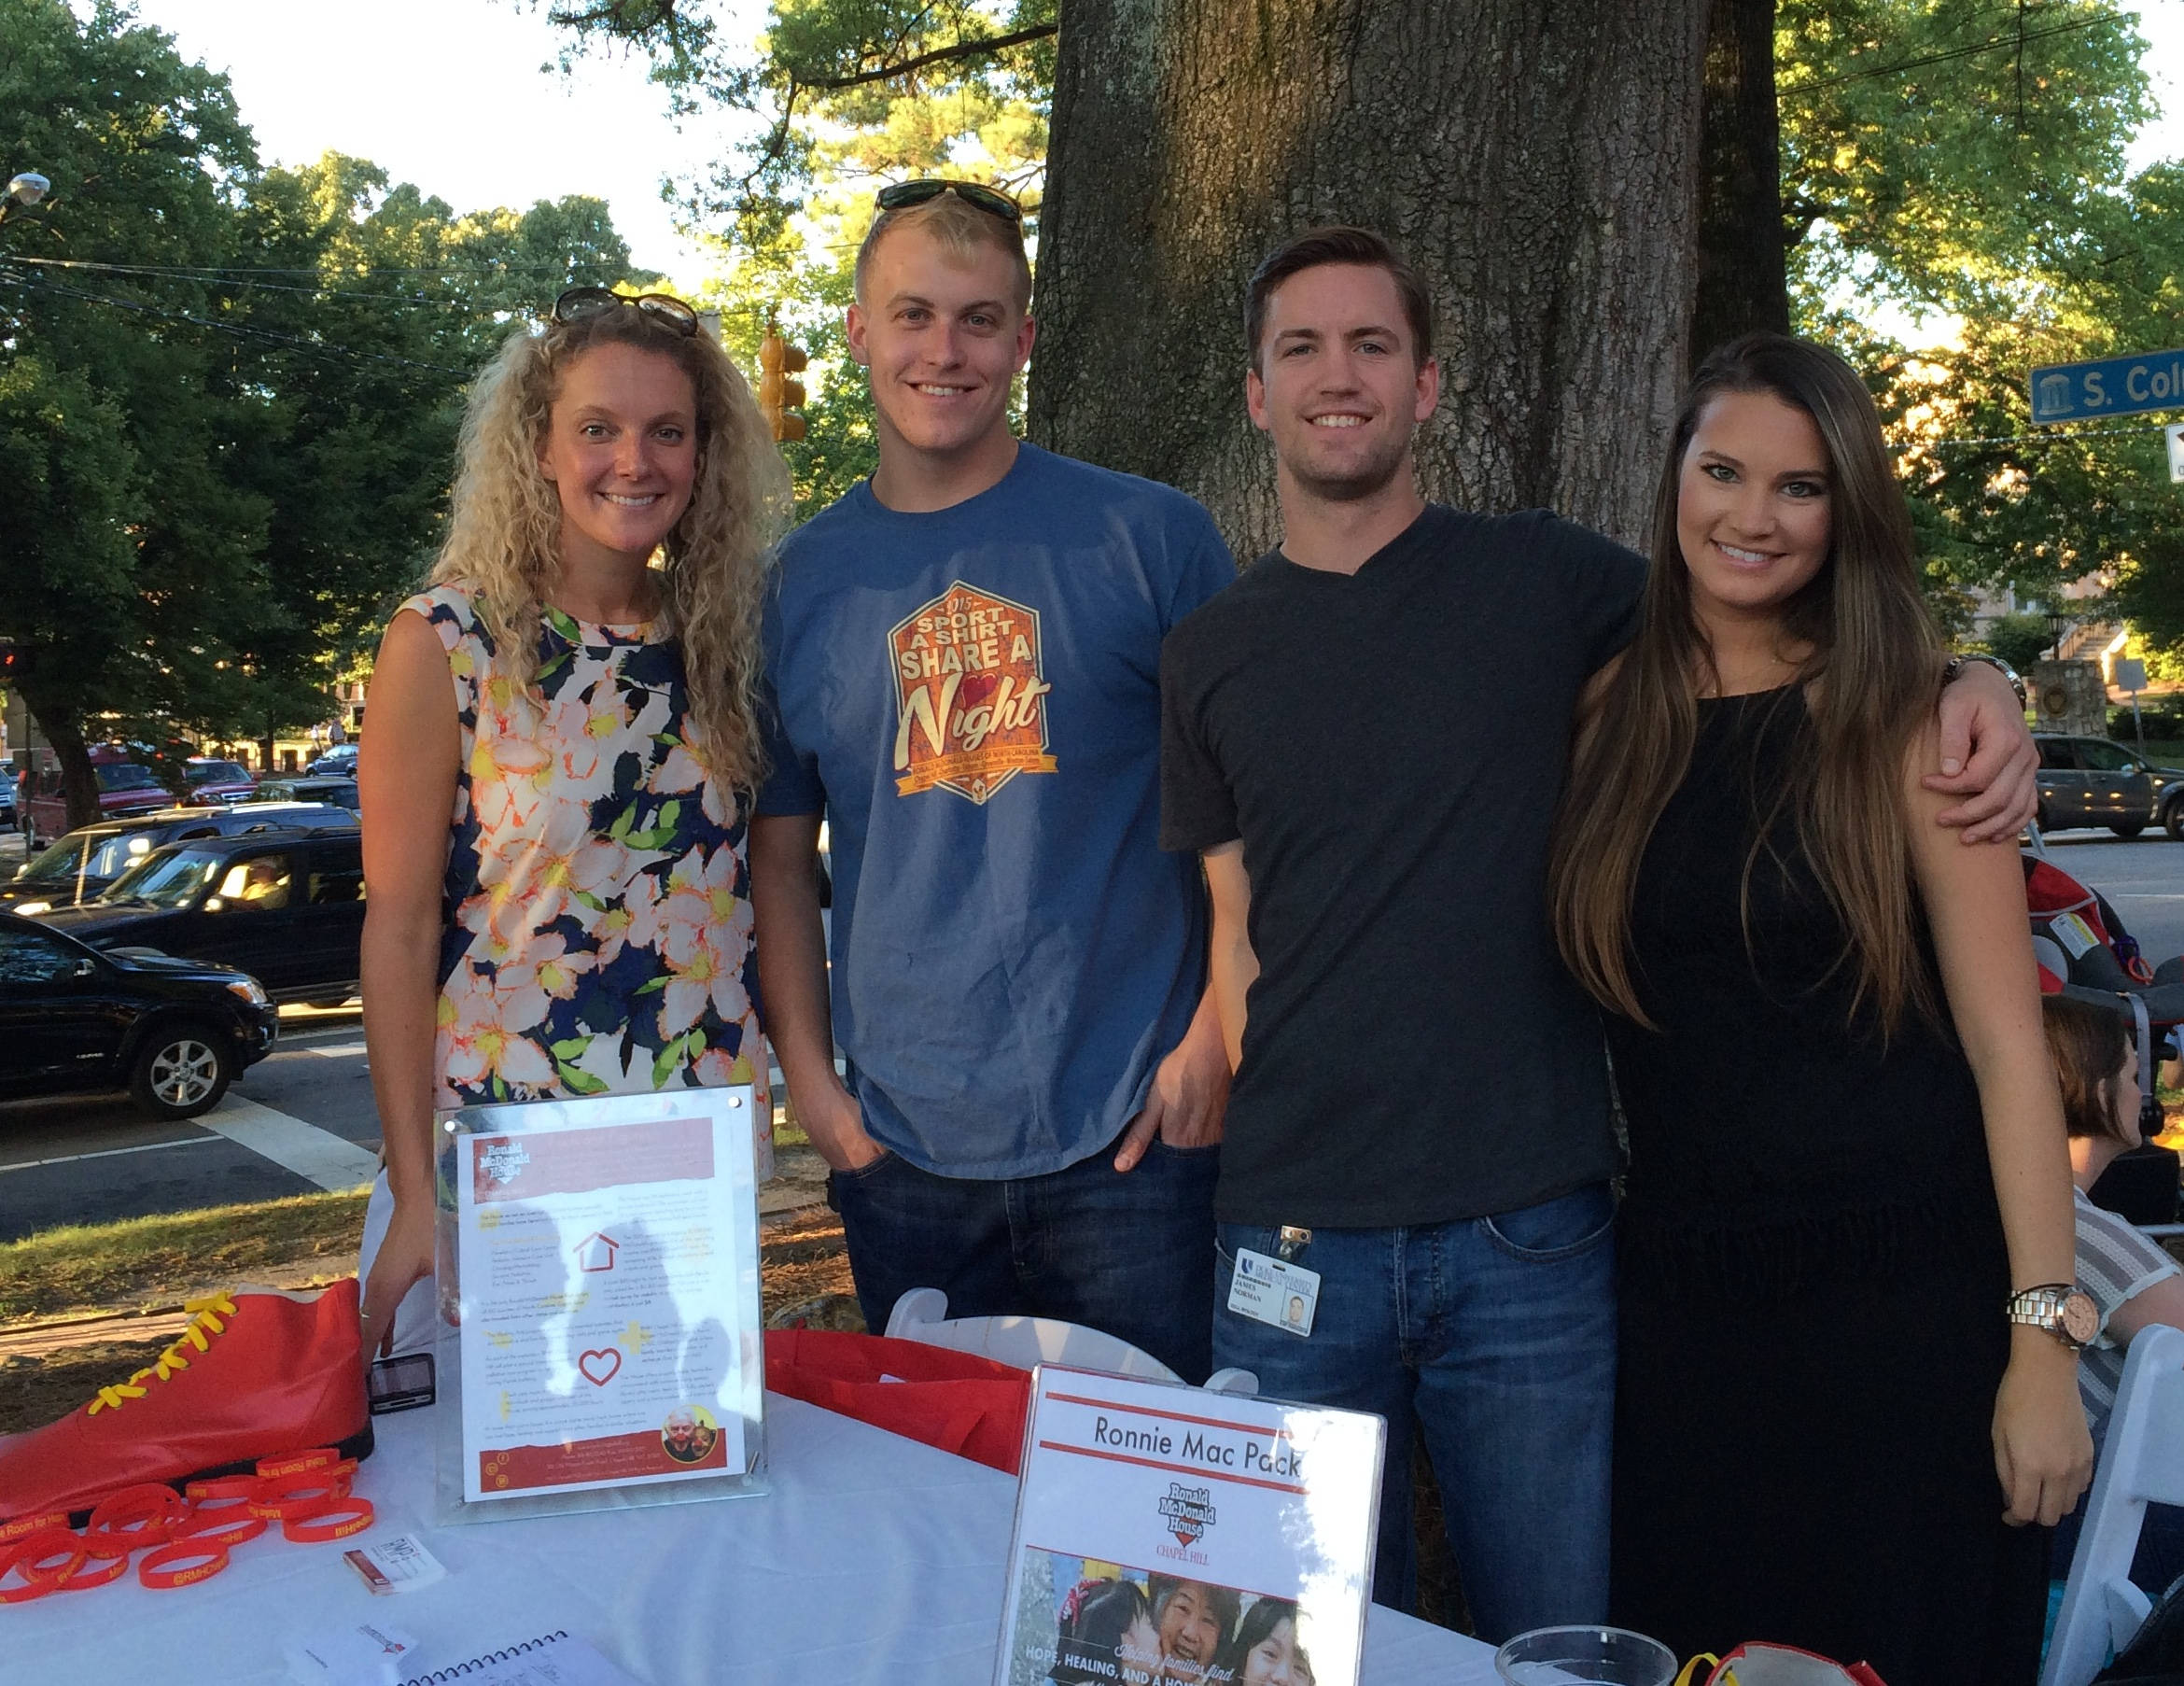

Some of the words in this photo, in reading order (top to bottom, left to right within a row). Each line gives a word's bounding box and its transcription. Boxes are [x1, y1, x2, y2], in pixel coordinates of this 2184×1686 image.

[2083, 372, 2113, 407] S.
[2126, 361, 2184, 402] Col
[917, 607, 1005, 634] SPORT
[911, 634, 930, 650] A
[935, 620, 1015, 645] SHIRT
[901, 639, 1001, 680] SHARE
[1010, 634, 1032, 664] A
[894, 670, 1052, 771] Night
[480, 1153, 530, 1169] McDonald
[1094, 1416, 1172, 1454] Ronnie
[1182, 1429, 1235, 1467] Mac
[1244, 1441, 1301, 1478] Pack
[1169, 1482, 1210, 1506] Ronald
[1159, 1497, 1216, 1524] McDonald
[7, 1523, 34, 1536] Room
[1168, 1516, 1204, 1538] House
[1156, 1545, 1188, 1562] CHAPEL
[1189, 1551, 1210, 1567] HILL
[1025, 1646, 1062, 1666] HOPE,
[1064, 1653, 1119, 1679] HEALING,
[1122, 1667, 1150, 1685] AND
[1153, 1675, 1162, 1686] A
[1159, 1653, 1205, 1677] families
[1201, 1664, 1235, 1681] find
